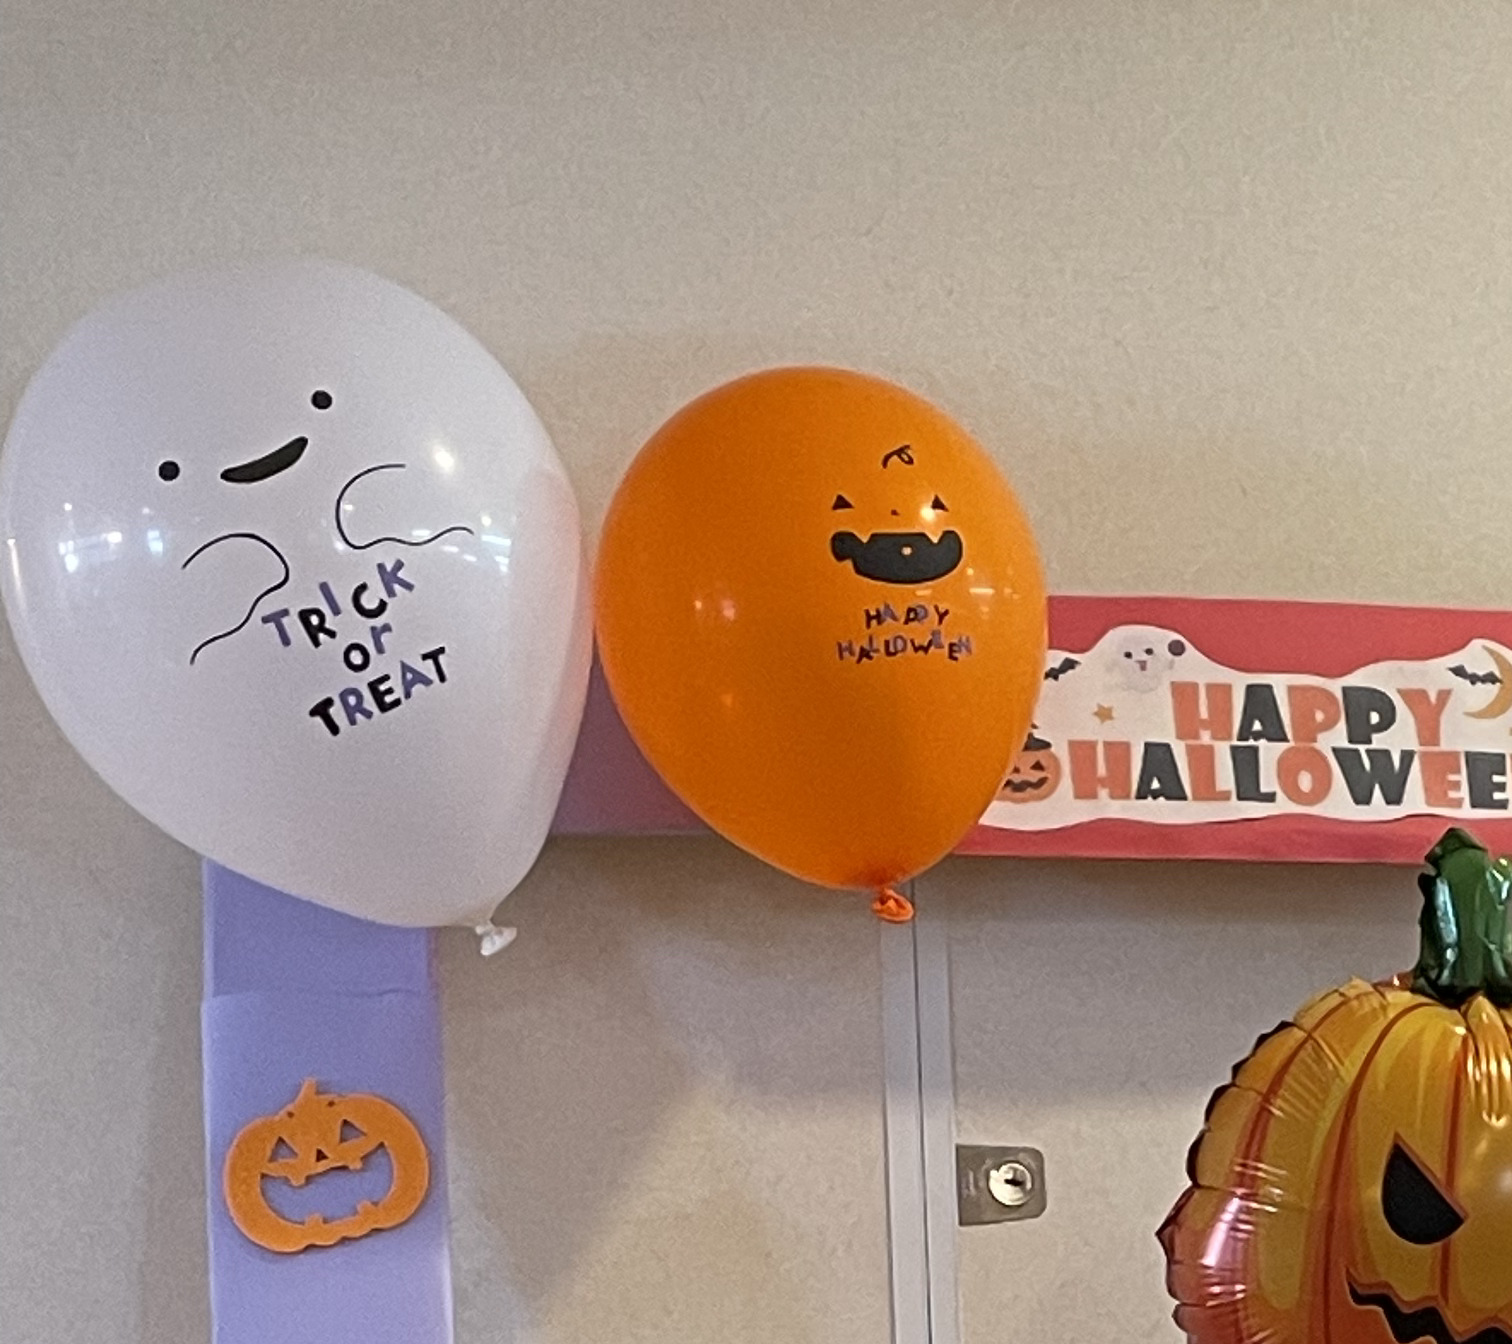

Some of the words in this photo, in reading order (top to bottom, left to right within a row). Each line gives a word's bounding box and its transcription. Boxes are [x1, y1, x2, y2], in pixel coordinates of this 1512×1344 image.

[261, 558, 416, 648] TRICK
[863, 603, 950, 630] HAPPY
[343, 621, 393, 673] or
[308, 646, 447, 737] TREAT
[1171, 681, 1454, 748] HAPPY
